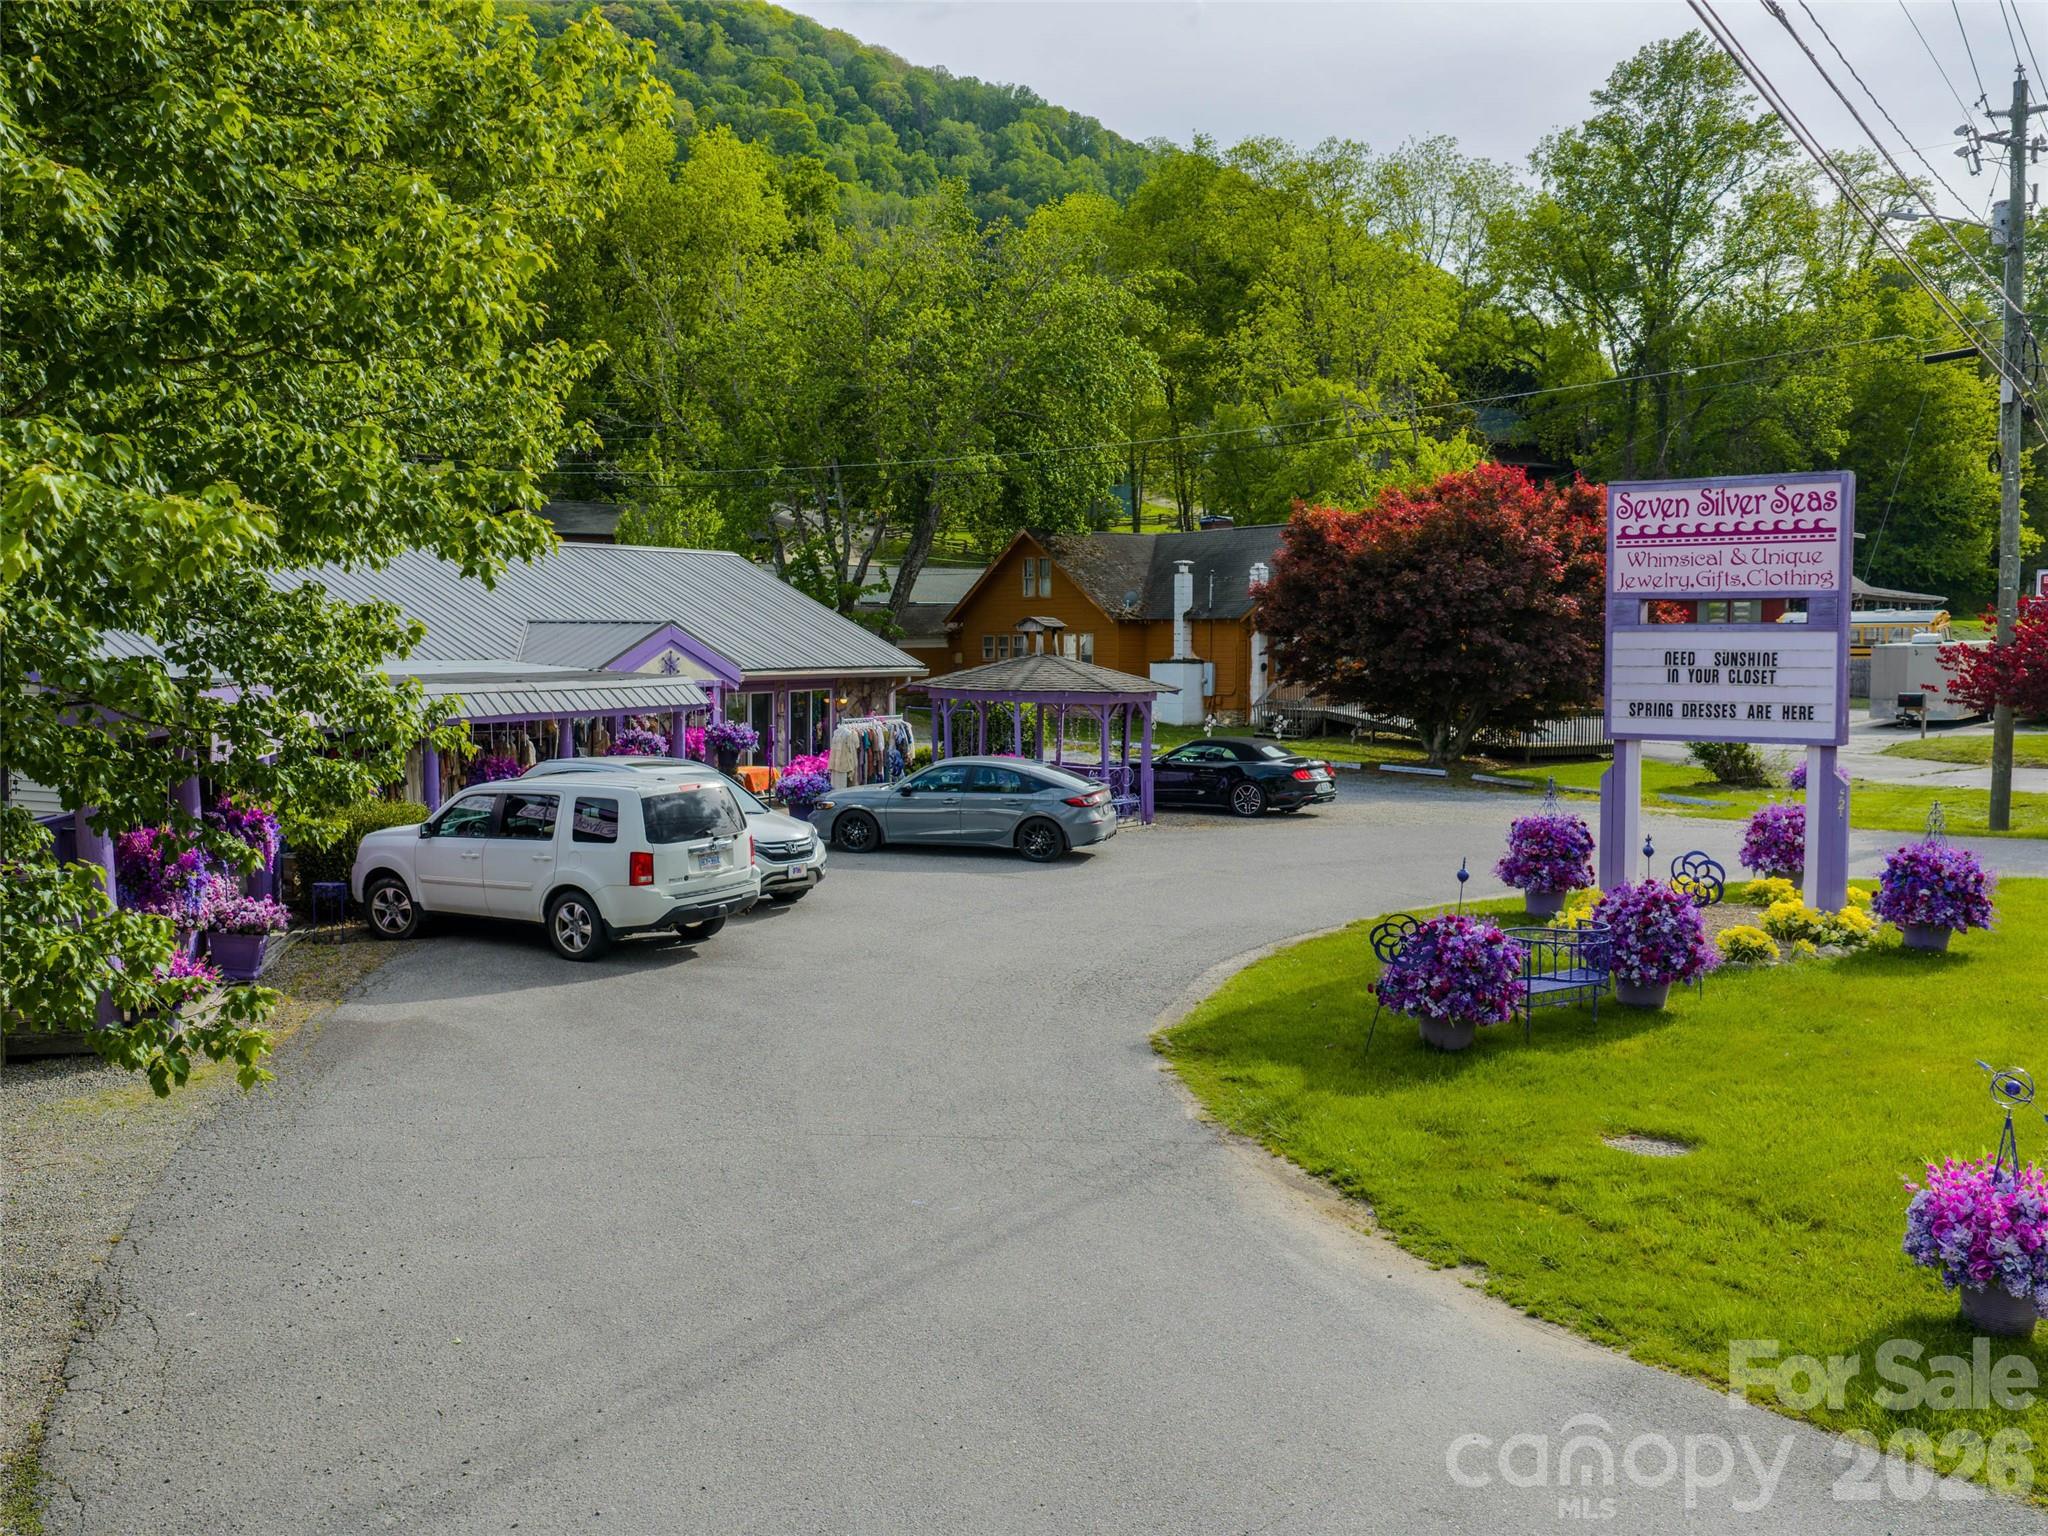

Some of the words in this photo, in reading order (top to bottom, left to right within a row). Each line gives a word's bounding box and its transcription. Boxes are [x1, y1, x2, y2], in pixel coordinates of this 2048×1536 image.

[1615, 491, 1690, 522] Seven
[1696, 487, 1767, 518] Silver
[1770, 483, 1838, 515] Seas
[1627, 550, 1723, 568] Whimsical
[1730, 547, 1748, 566] &
[1750, 547, 1824, 567] Unique
[1664, 651, 1696, 666] NEED
[1667, 668, 1679, 683] IN
[1688, 669, 1720, 683] YOUR
[1728, 669, 1777, 685] CLOSET
[1628, 702, 1674, 717] SPRING
[1681, 703, 1737, 719] DRESSES
[1747, 704, 1773, 720] ARE
[1782, 705, 1815, 721] HERE
